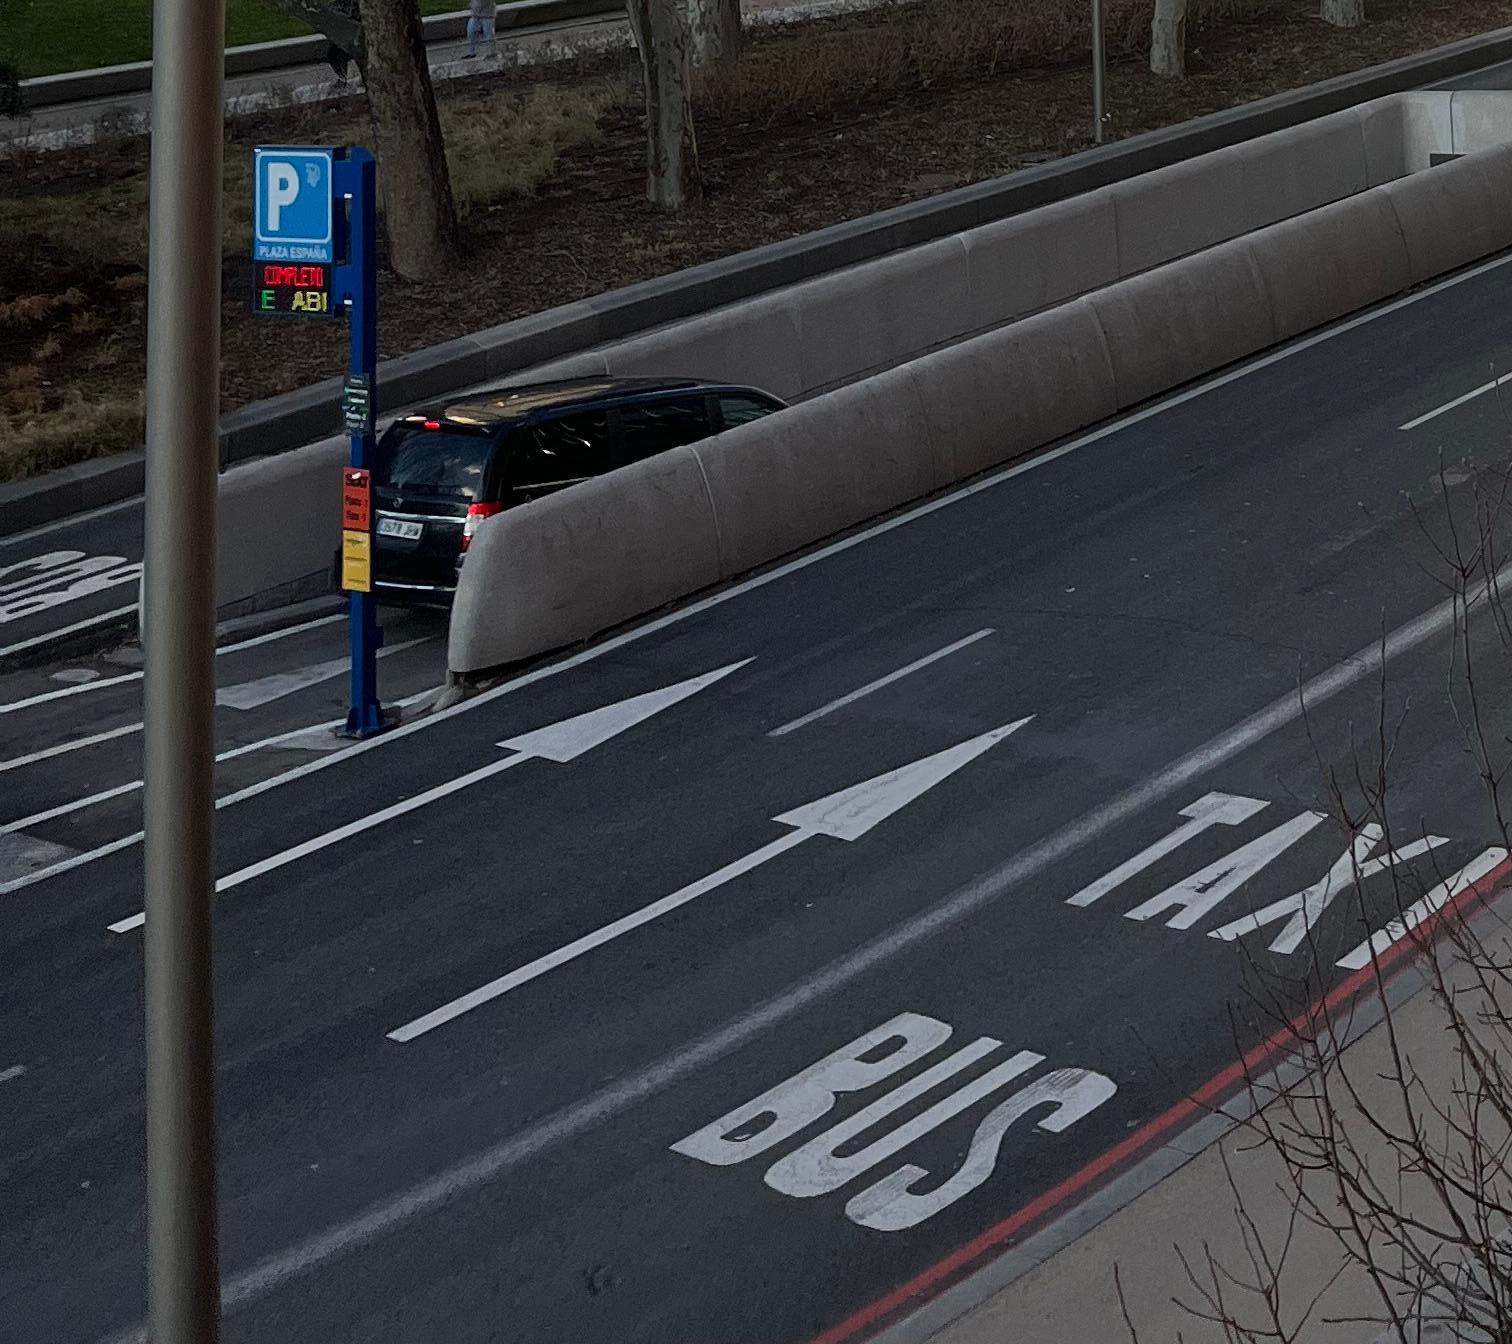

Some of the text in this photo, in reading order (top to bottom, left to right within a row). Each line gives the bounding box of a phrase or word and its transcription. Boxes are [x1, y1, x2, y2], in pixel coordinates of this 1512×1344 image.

[267, 162, 299, 231] P
[258, 244, 328, 260] PLAZA ESPAÑA
[669, 1011, 1119, 1232] BUS
